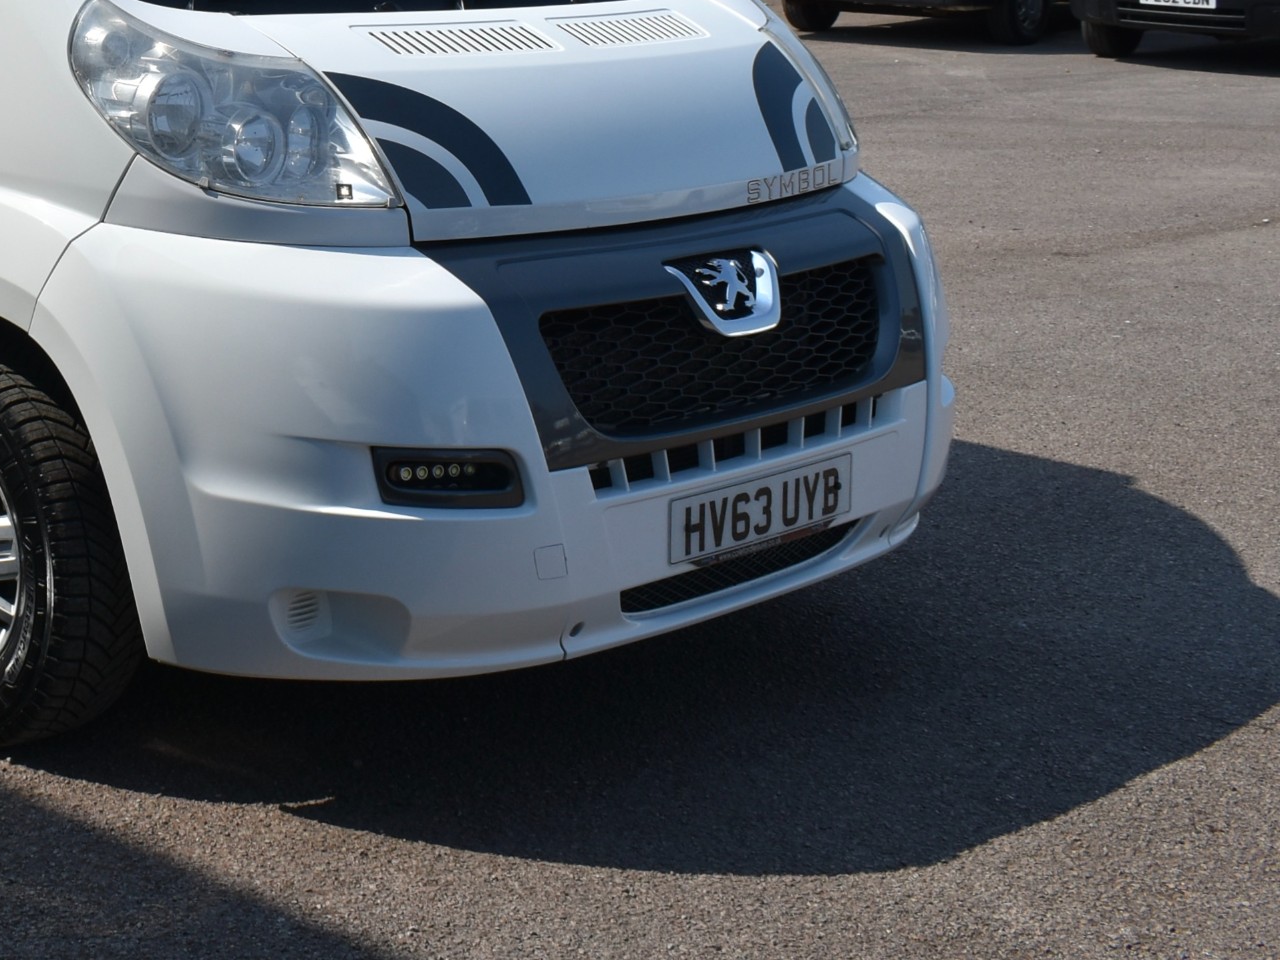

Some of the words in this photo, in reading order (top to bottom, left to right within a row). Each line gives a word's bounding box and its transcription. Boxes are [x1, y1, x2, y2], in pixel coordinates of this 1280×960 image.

[747, 163, 838, 204] SYMBOL
[685, 486, 772, 556] HV63
[782, 468, 840, 527] UYB
